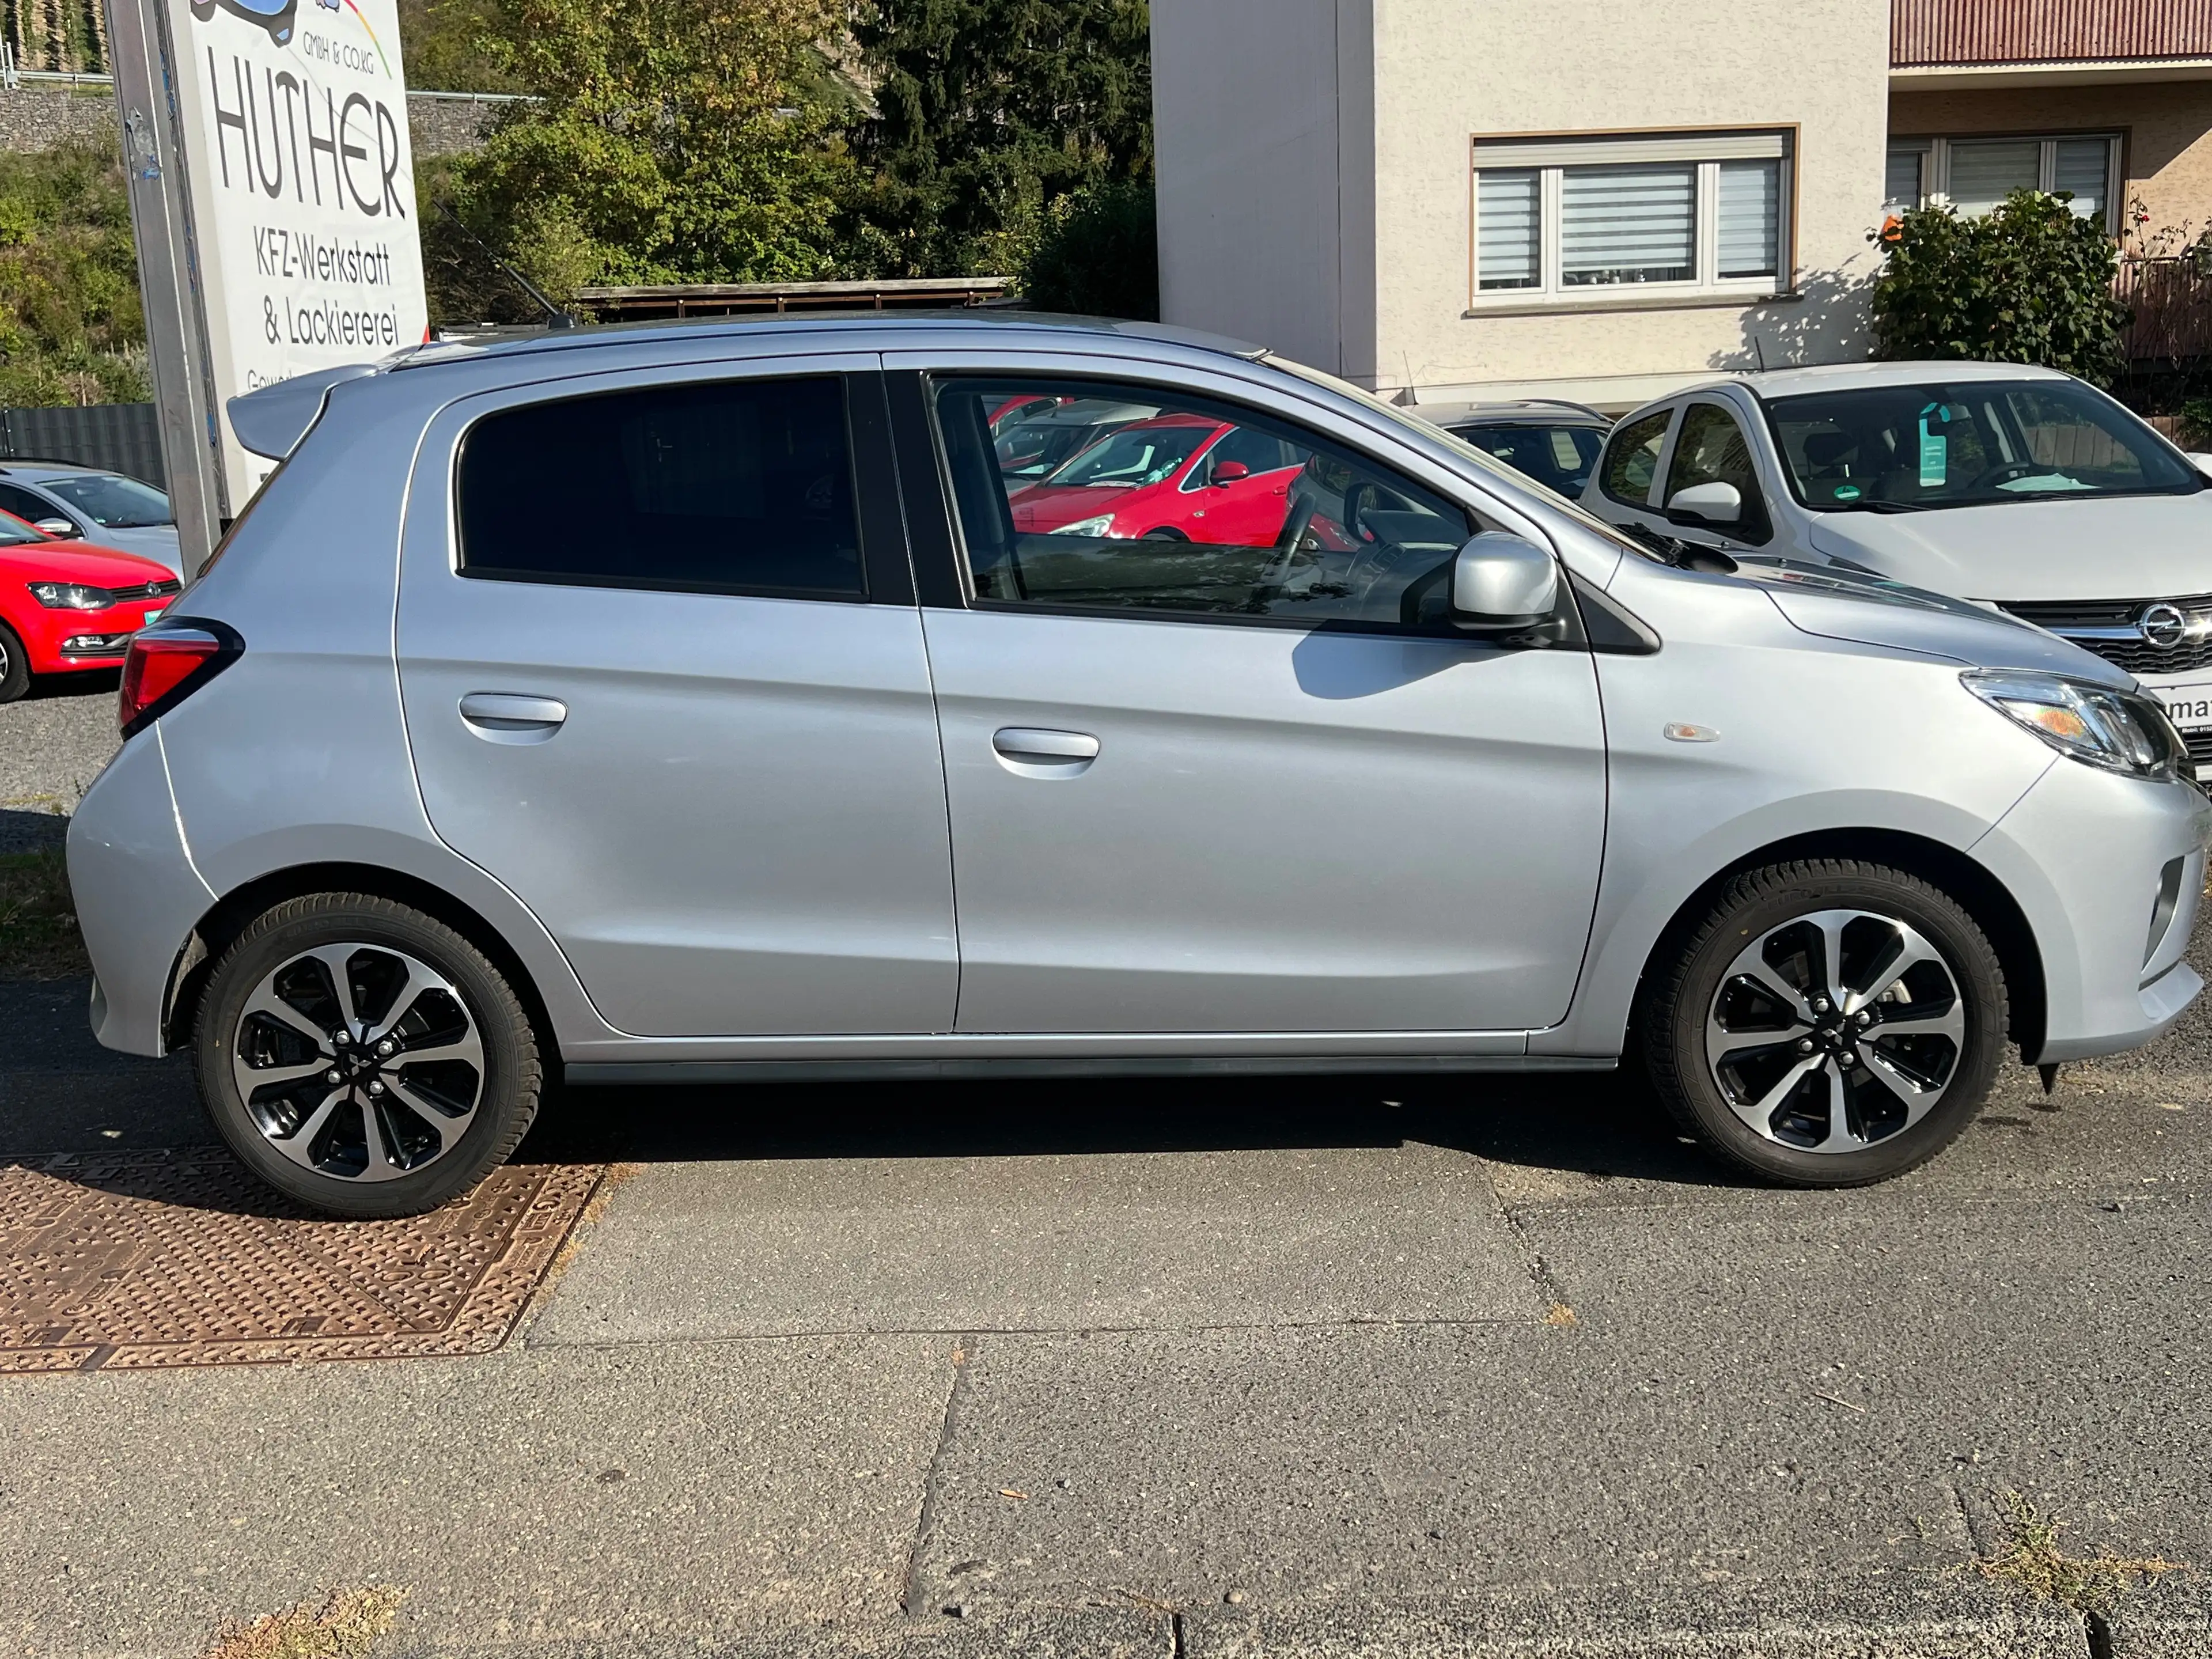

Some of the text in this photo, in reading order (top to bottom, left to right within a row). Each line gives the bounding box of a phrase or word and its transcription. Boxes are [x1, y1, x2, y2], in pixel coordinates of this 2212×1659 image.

[303, 31, 330, 62] GMBH
[333, 41, 340, 65] &
[207, 45, 406, 220] HUTHER
[253, 225, 391, 286] KFZ-Werkstatt
[264, 294, 399, 346] & Lackiererei
